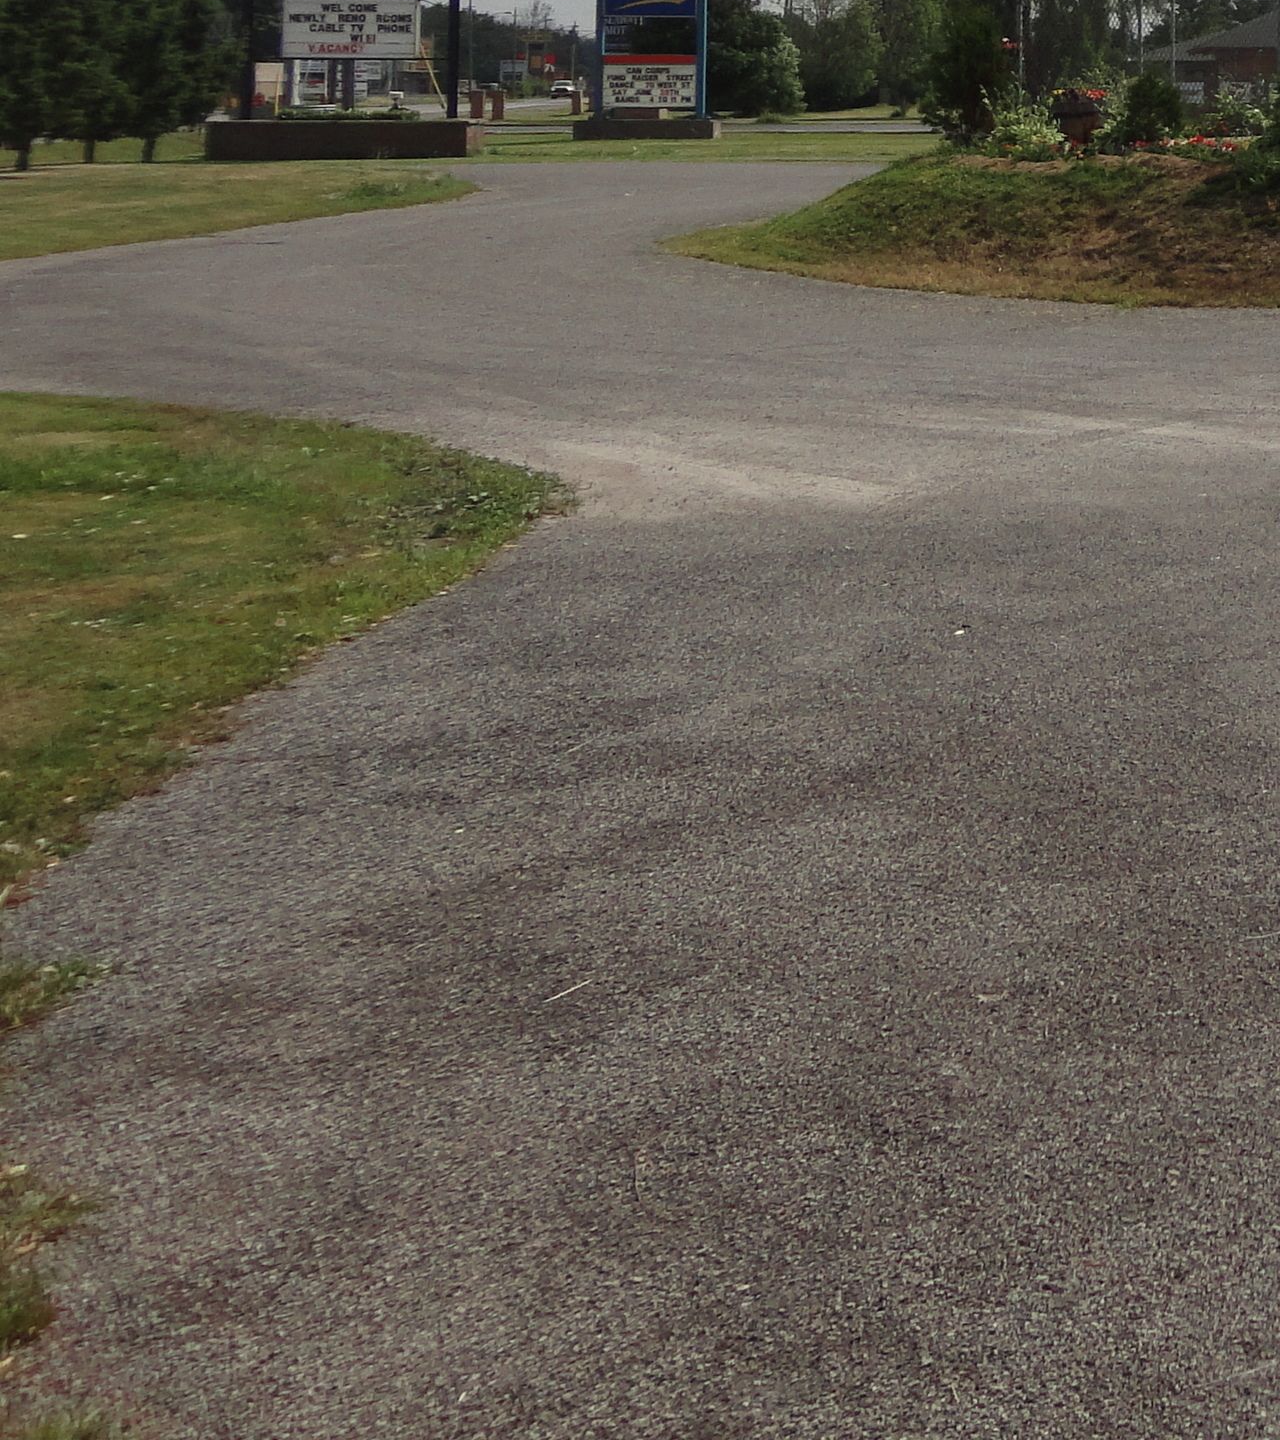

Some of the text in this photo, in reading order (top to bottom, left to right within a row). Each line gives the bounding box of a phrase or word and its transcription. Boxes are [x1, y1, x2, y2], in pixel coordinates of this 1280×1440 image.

[289, 13, 326, 23] NEWLY
[338, 13, 366, 22] RENO
[309, 23, 412, 33] CABLE TV PHONE
